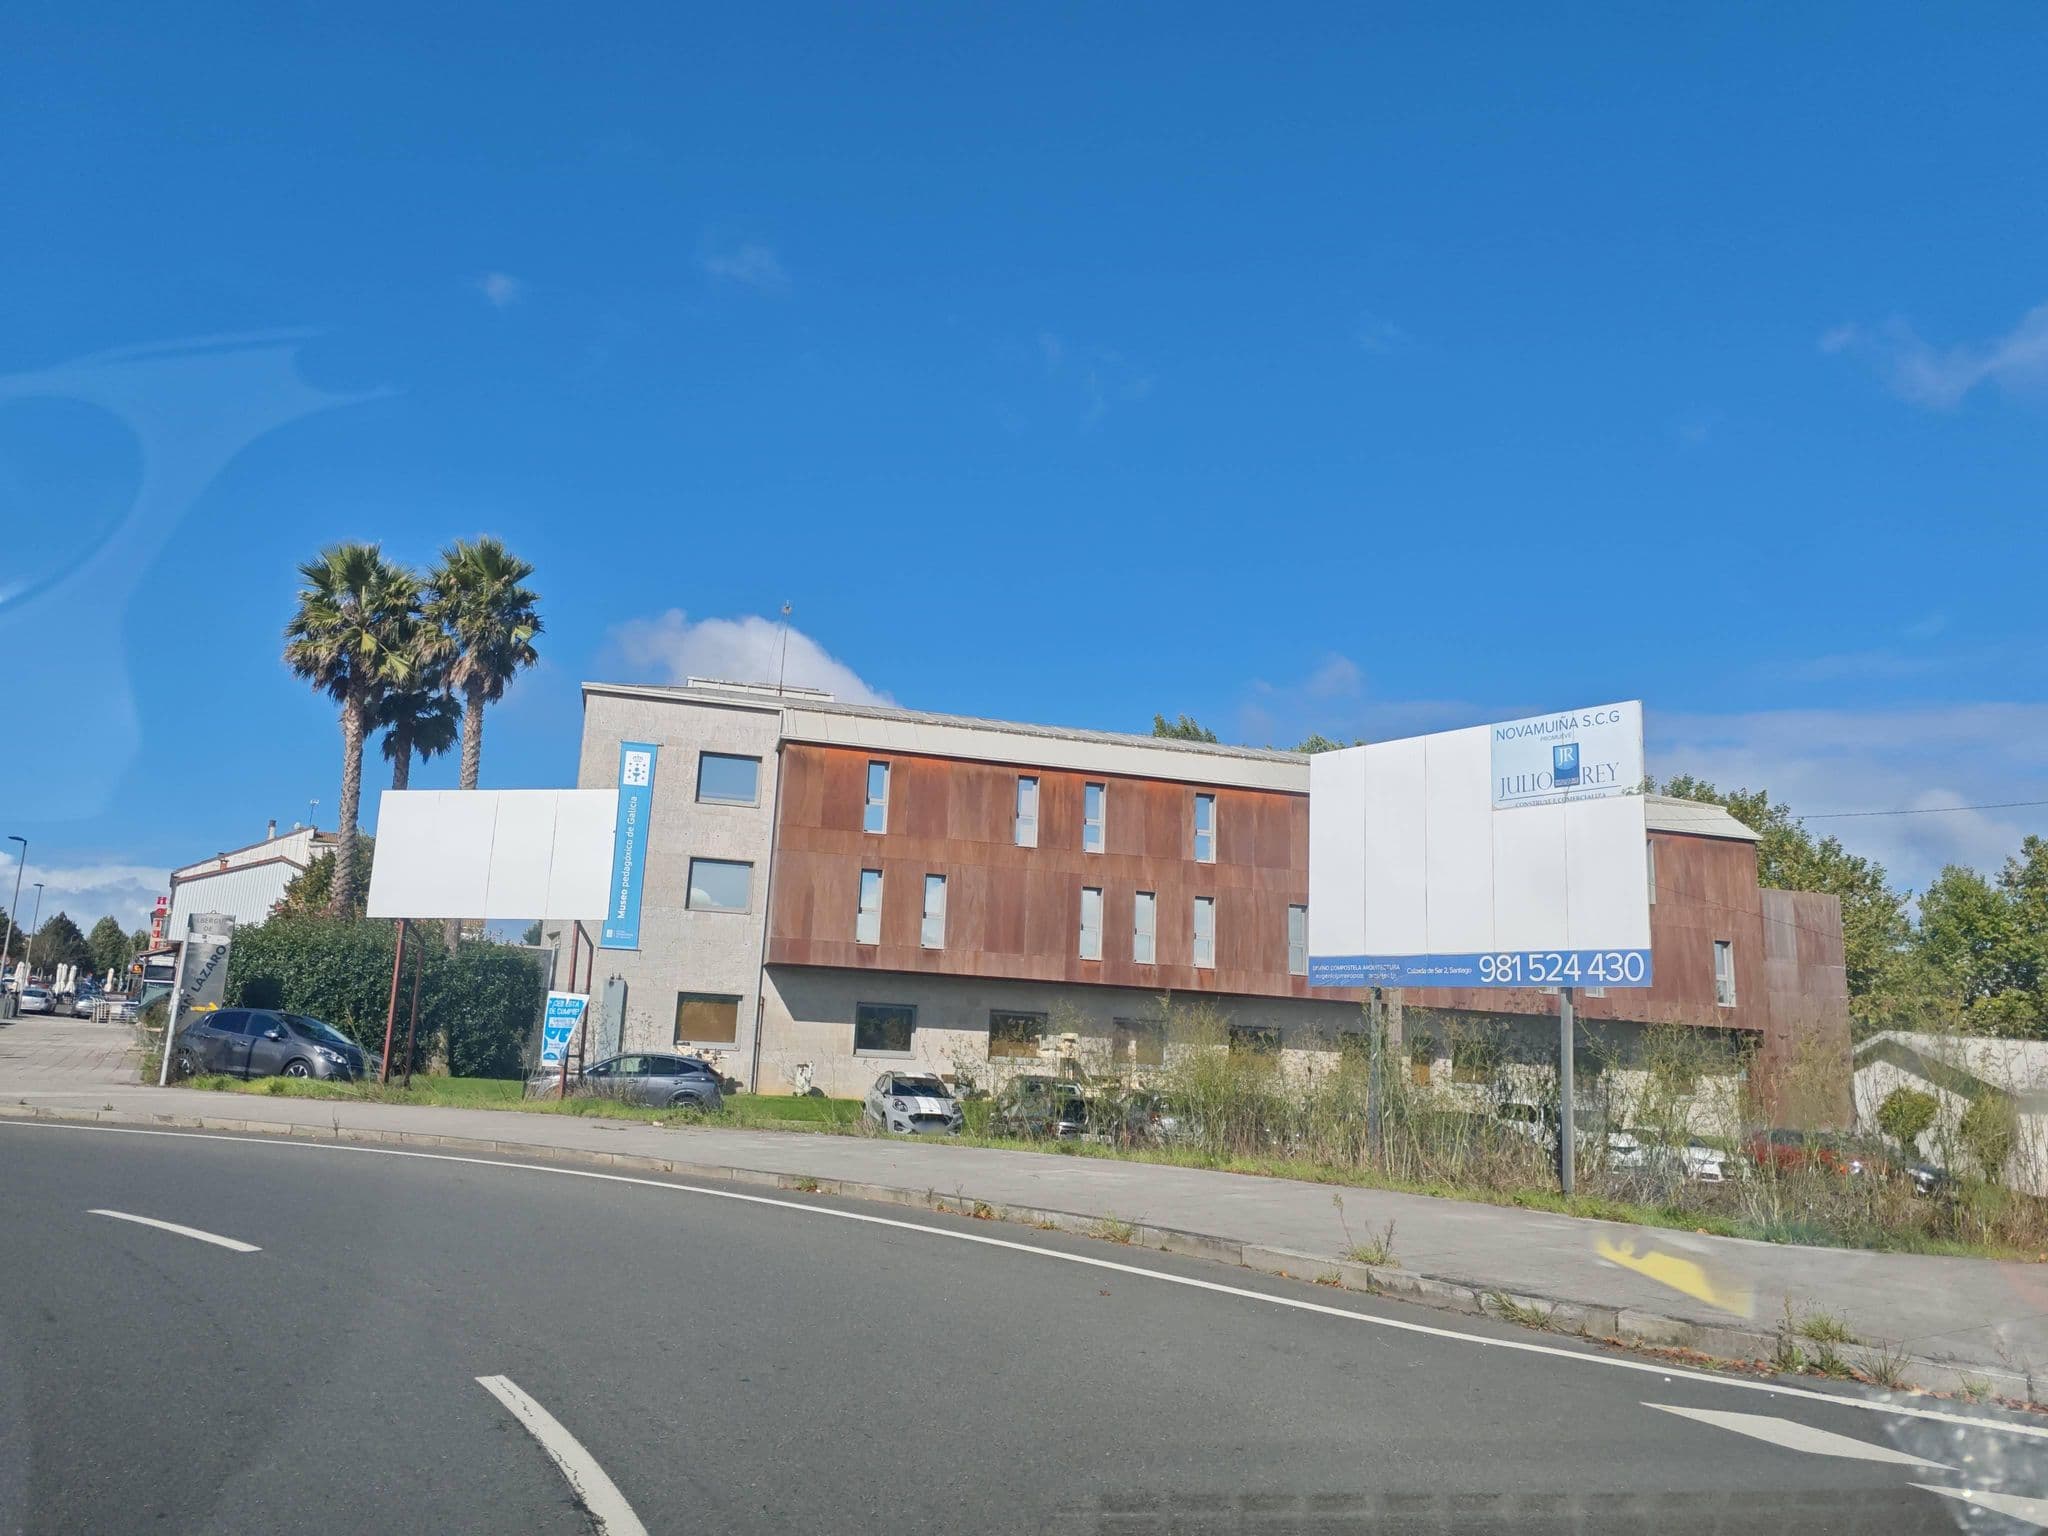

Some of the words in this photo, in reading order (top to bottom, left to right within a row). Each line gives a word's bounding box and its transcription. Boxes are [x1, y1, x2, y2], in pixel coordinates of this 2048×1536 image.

[1496, 716, 1578, 742] NOVAMUIÑA
[1582, 710, 1620, 727] S.C.G
[1558, 747, 1574, 767] JR
[1500, 771, 1553, 798] JULIO
[1582, 762, 1620, 785] REY
[627, 796, 638, 825] Galicia
[1558, 792, 1606, 804] COMERCIALIZA
[627, 827, 635, 838] de
[622, 840, 634, 887] pedagóxico
[616, 888, 628, 919] Museo
[1479, 955, 1521, 983] 981
[1528, 953, 1582, 982] 524
[1587, 952, 1645, 982] 430
